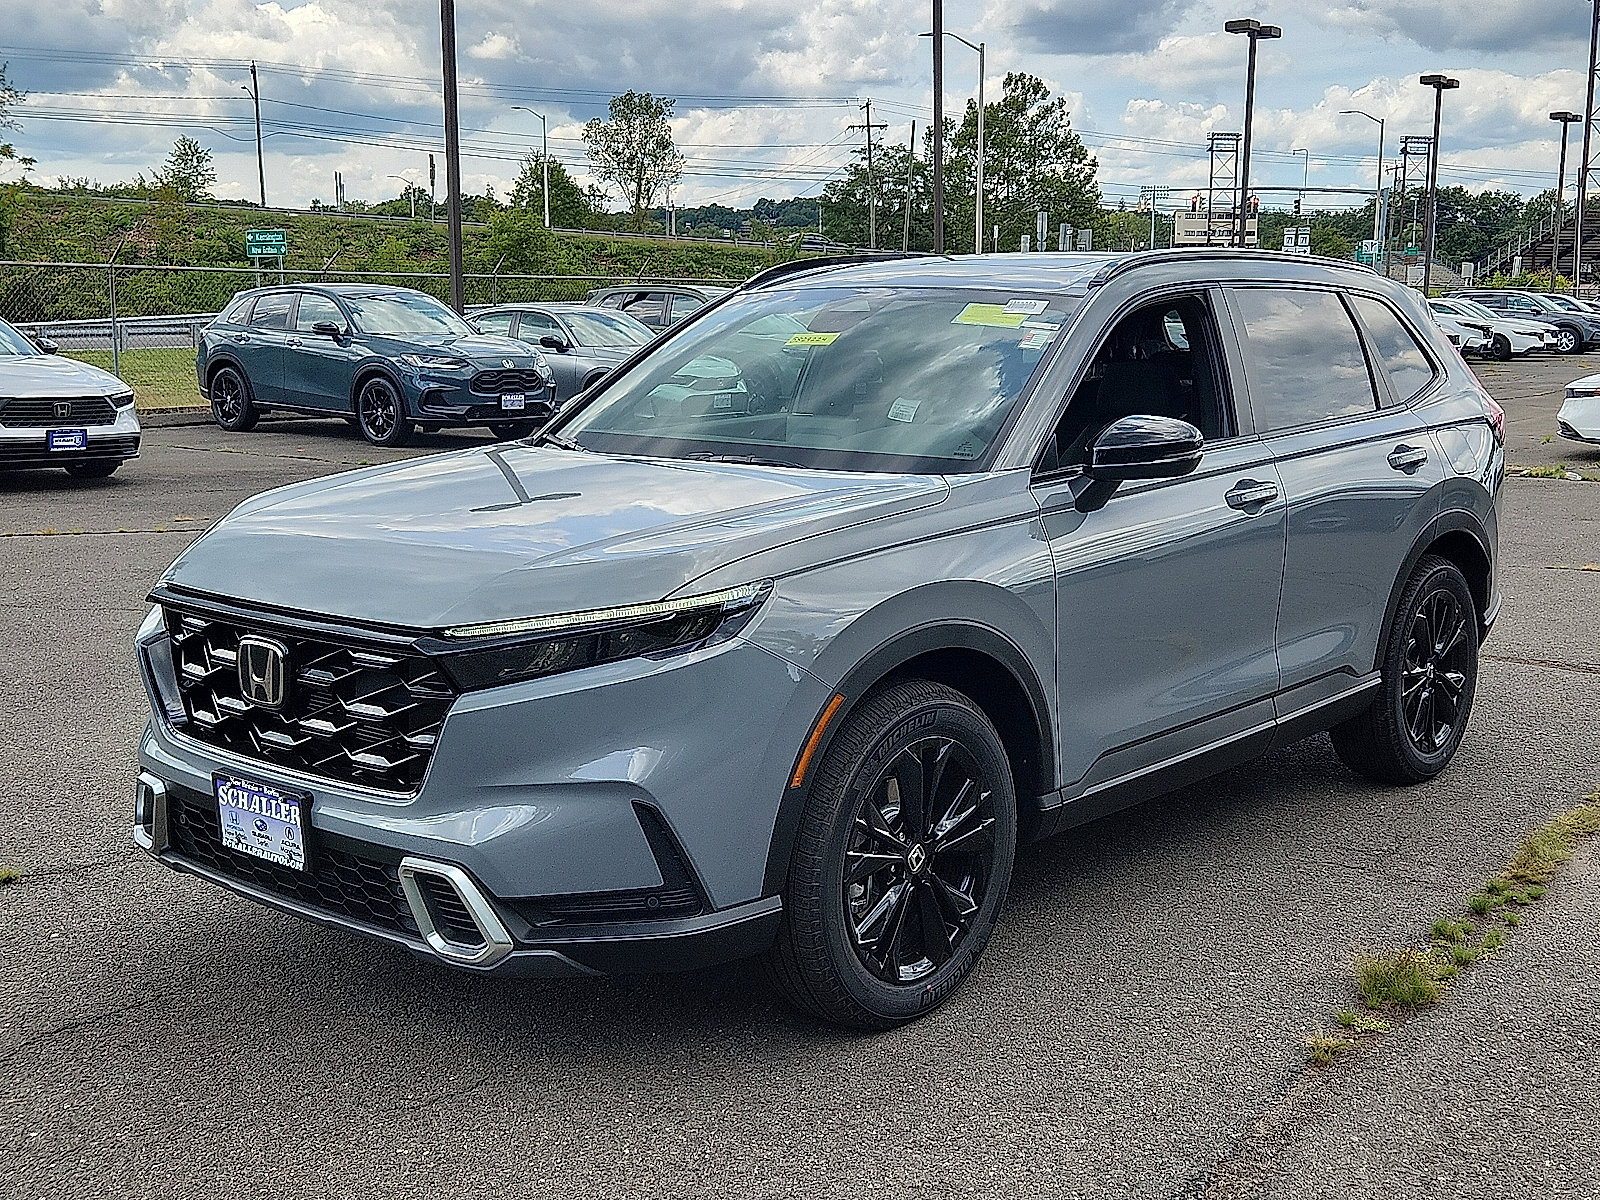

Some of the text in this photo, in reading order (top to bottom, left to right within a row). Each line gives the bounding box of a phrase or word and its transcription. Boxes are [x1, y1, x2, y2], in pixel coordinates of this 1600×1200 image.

[1286, 236, 1293, 244] 71
[1300, 236, 1307, 244] 71
[878, 712, 936, 759] MICHELIN
[218, 785, 300, 825] SCHALLER
[922, 951, 973, 1006] MICHELIN
